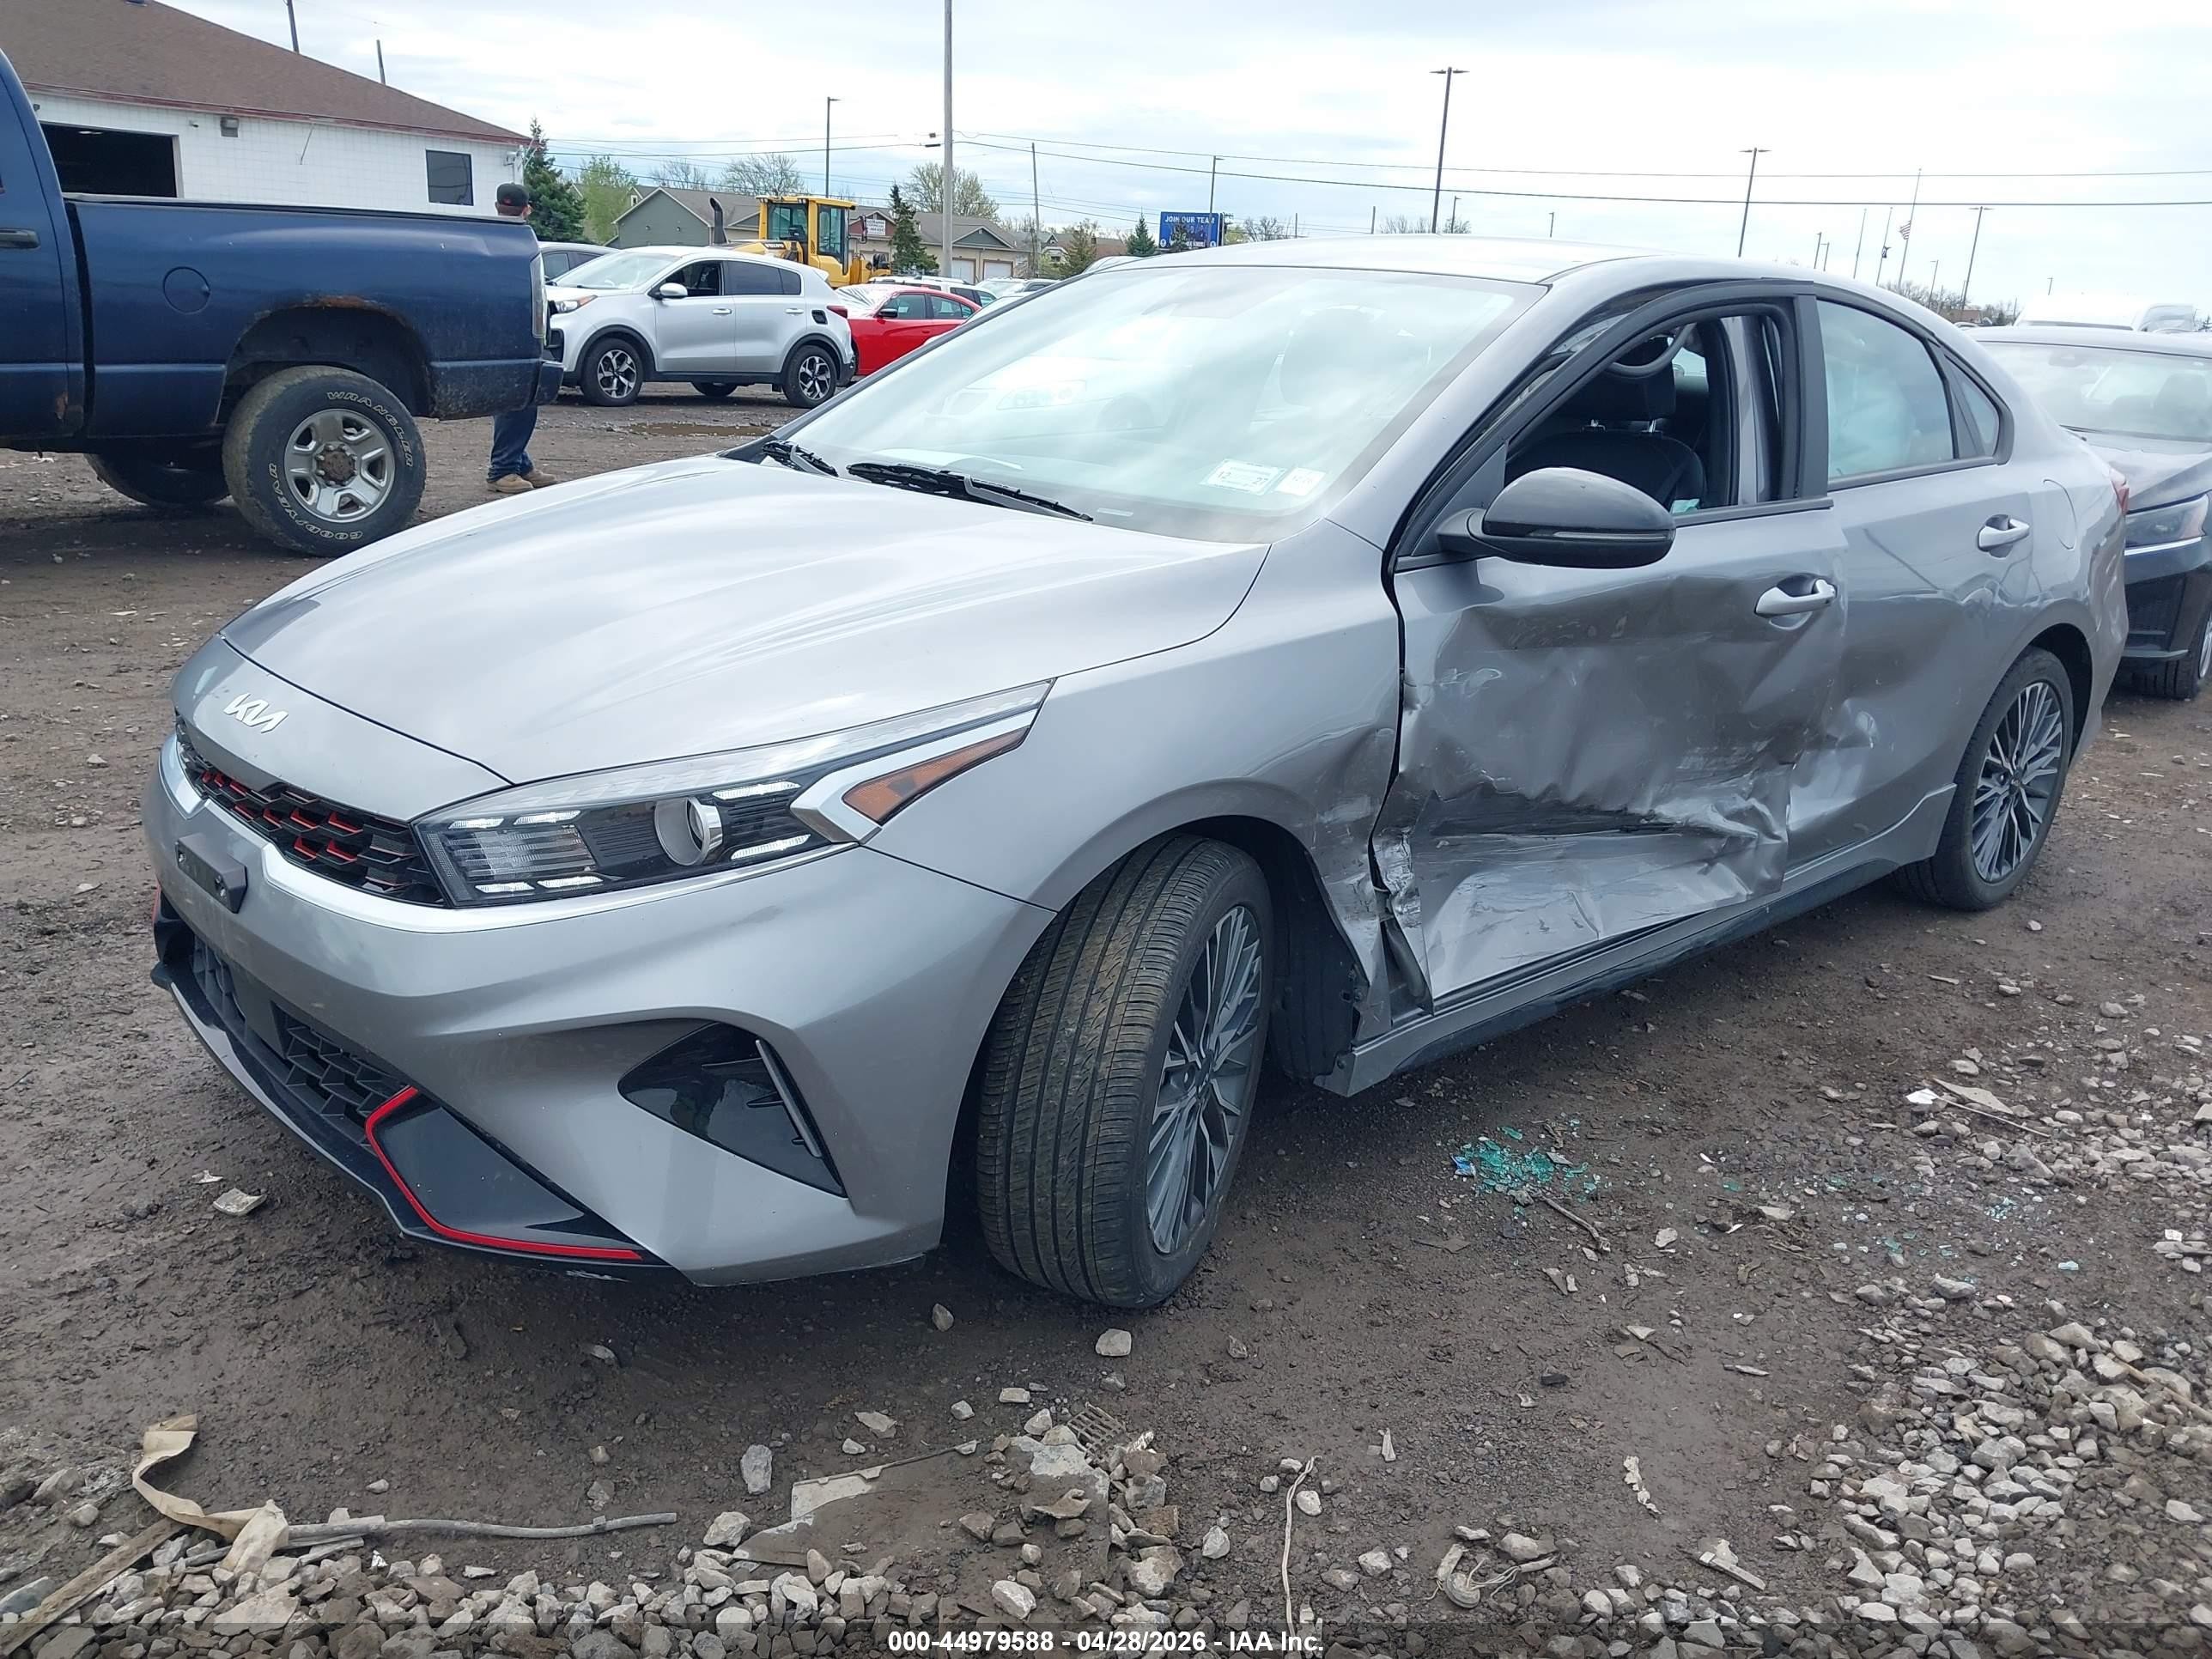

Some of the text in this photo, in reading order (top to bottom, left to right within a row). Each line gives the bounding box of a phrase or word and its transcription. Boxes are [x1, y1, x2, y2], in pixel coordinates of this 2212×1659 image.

[1164, 215, 1180, 223] JOIN
[326, 391, 414, 467] WRANGLER
[223, 692, 289, 734] KIA
